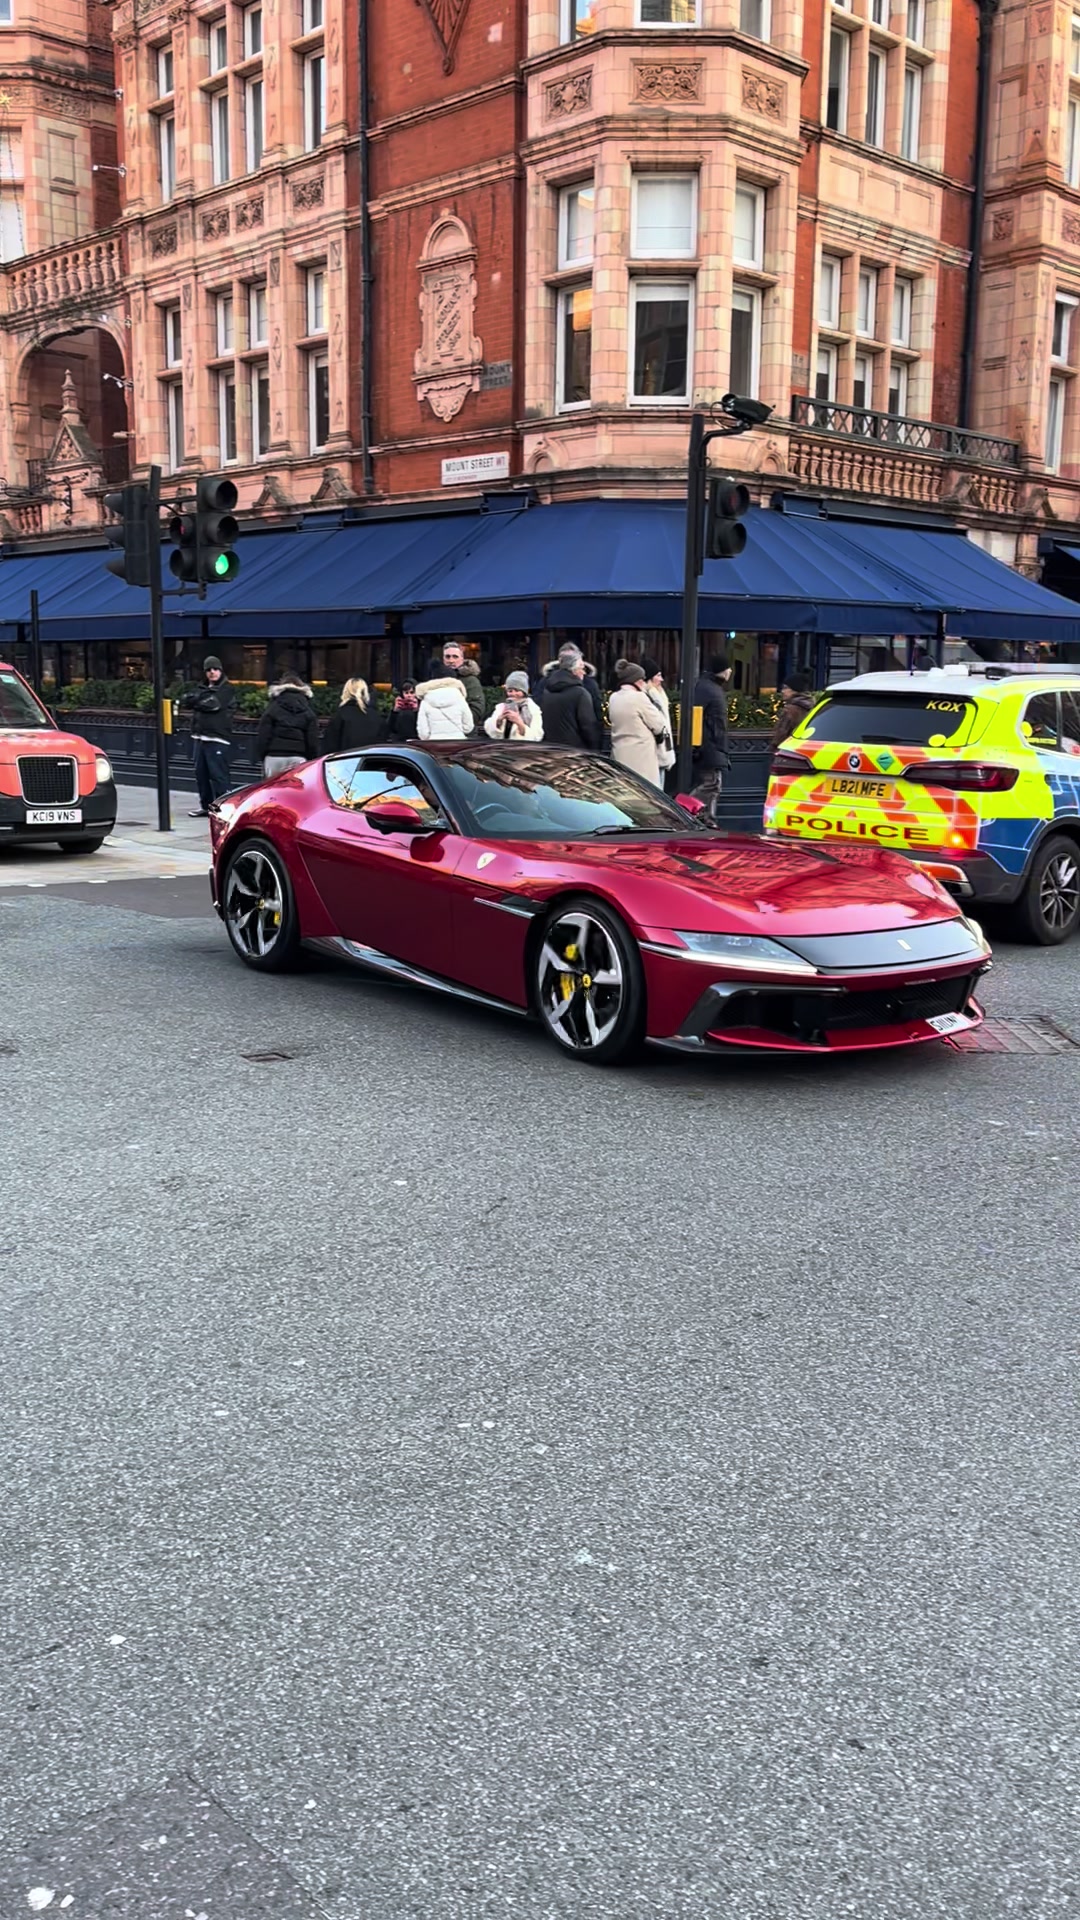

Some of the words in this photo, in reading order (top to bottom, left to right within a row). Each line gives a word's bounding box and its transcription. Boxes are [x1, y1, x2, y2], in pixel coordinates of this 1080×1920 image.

[445, 460, 469, 472] MOUNT
[471, 457, 494, 469] STREET
[925, 700, 963, 713] KQX
[831, 779, 859, 794] LB21
[860, 781, 886, 796] MFE
[32, 811, 55, 822] KC19
[57, 811, 76, 821] VNS
[786, 815, 929, 841] POLICE
